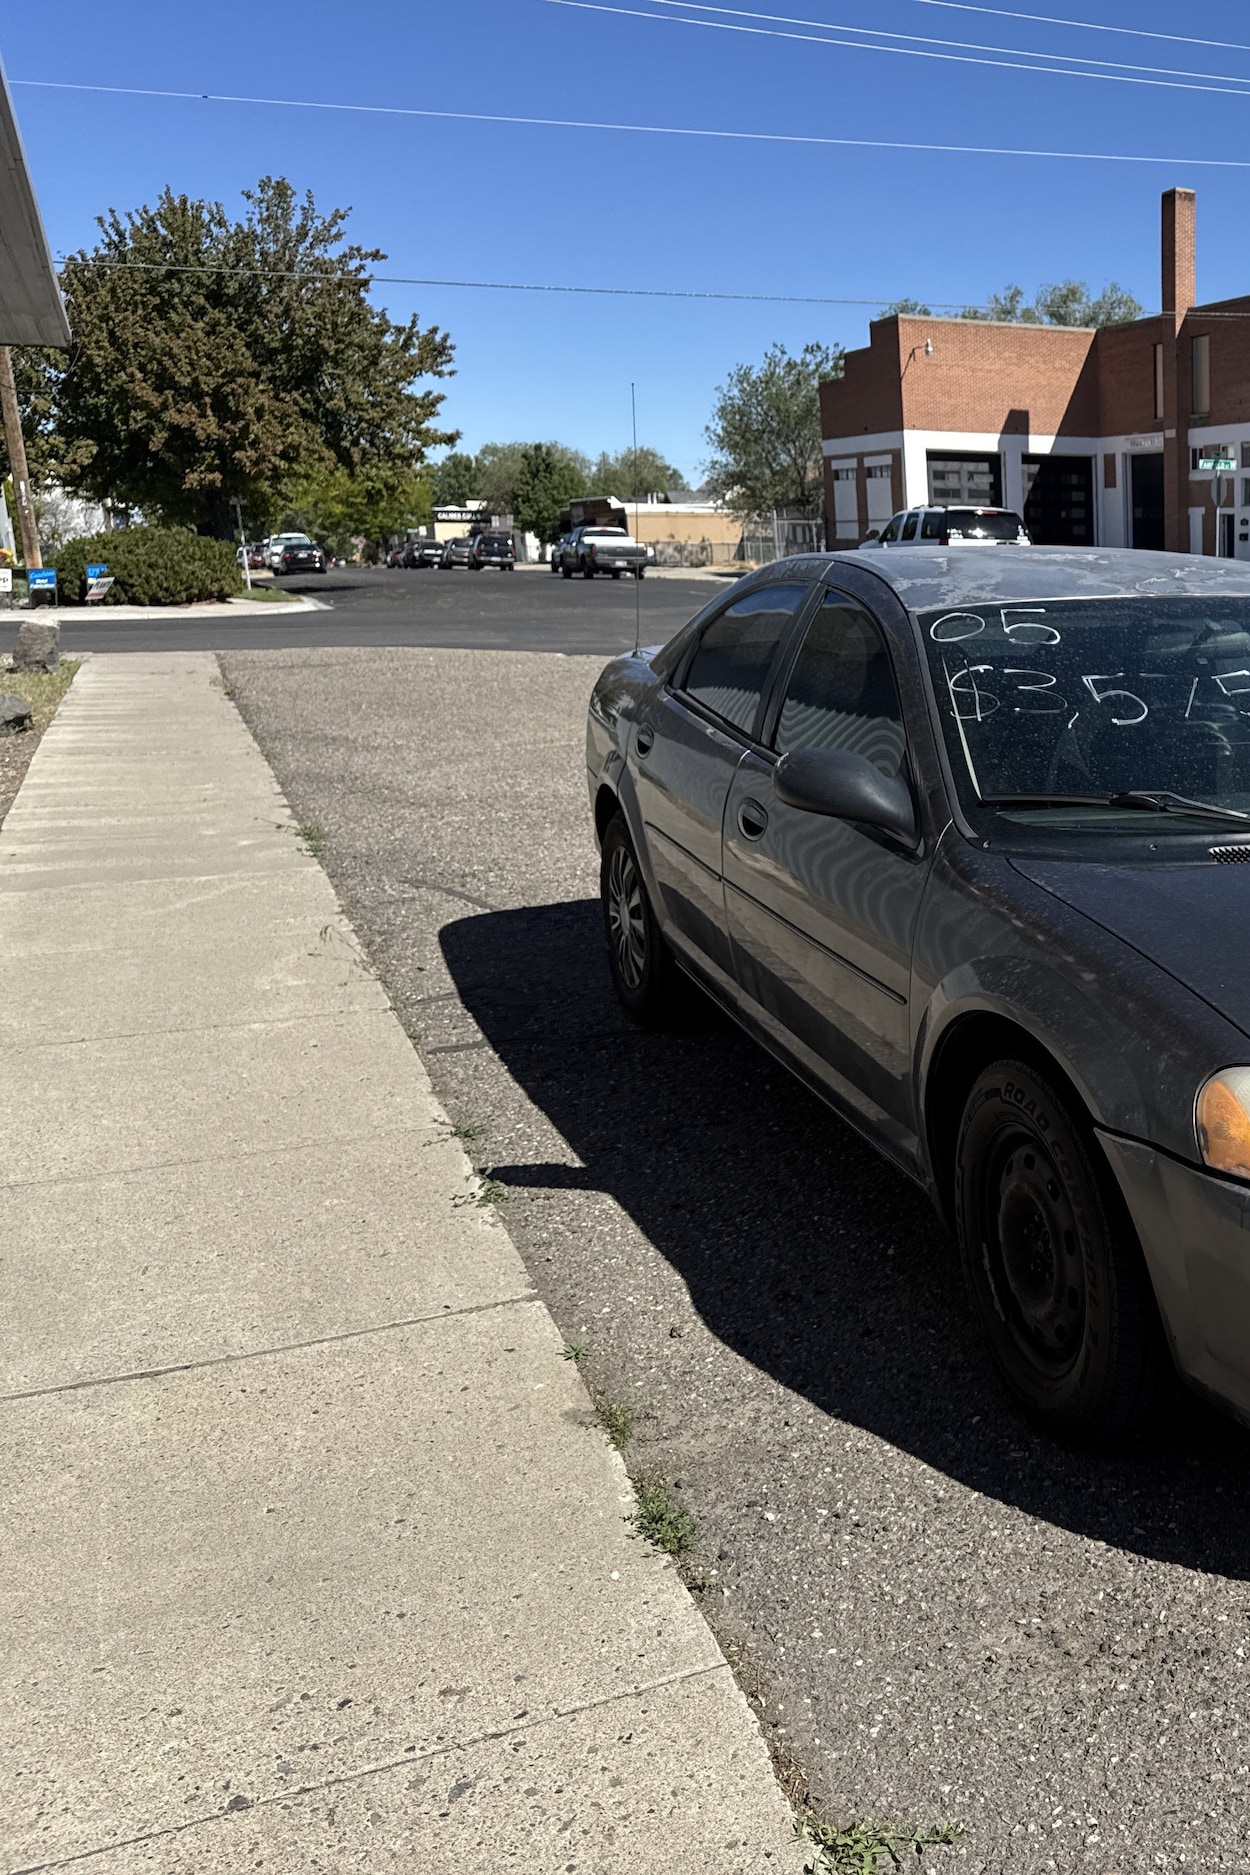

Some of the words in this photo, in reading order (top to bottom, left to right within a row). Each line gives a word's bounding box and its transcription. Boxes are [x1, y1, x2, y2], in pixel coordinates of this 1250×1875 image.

[929, 608, 1061, 645] 05
[1003, 1080, 1051, 1134] ROAD
[1050, 1139, 1099, 1307] CONTROL
